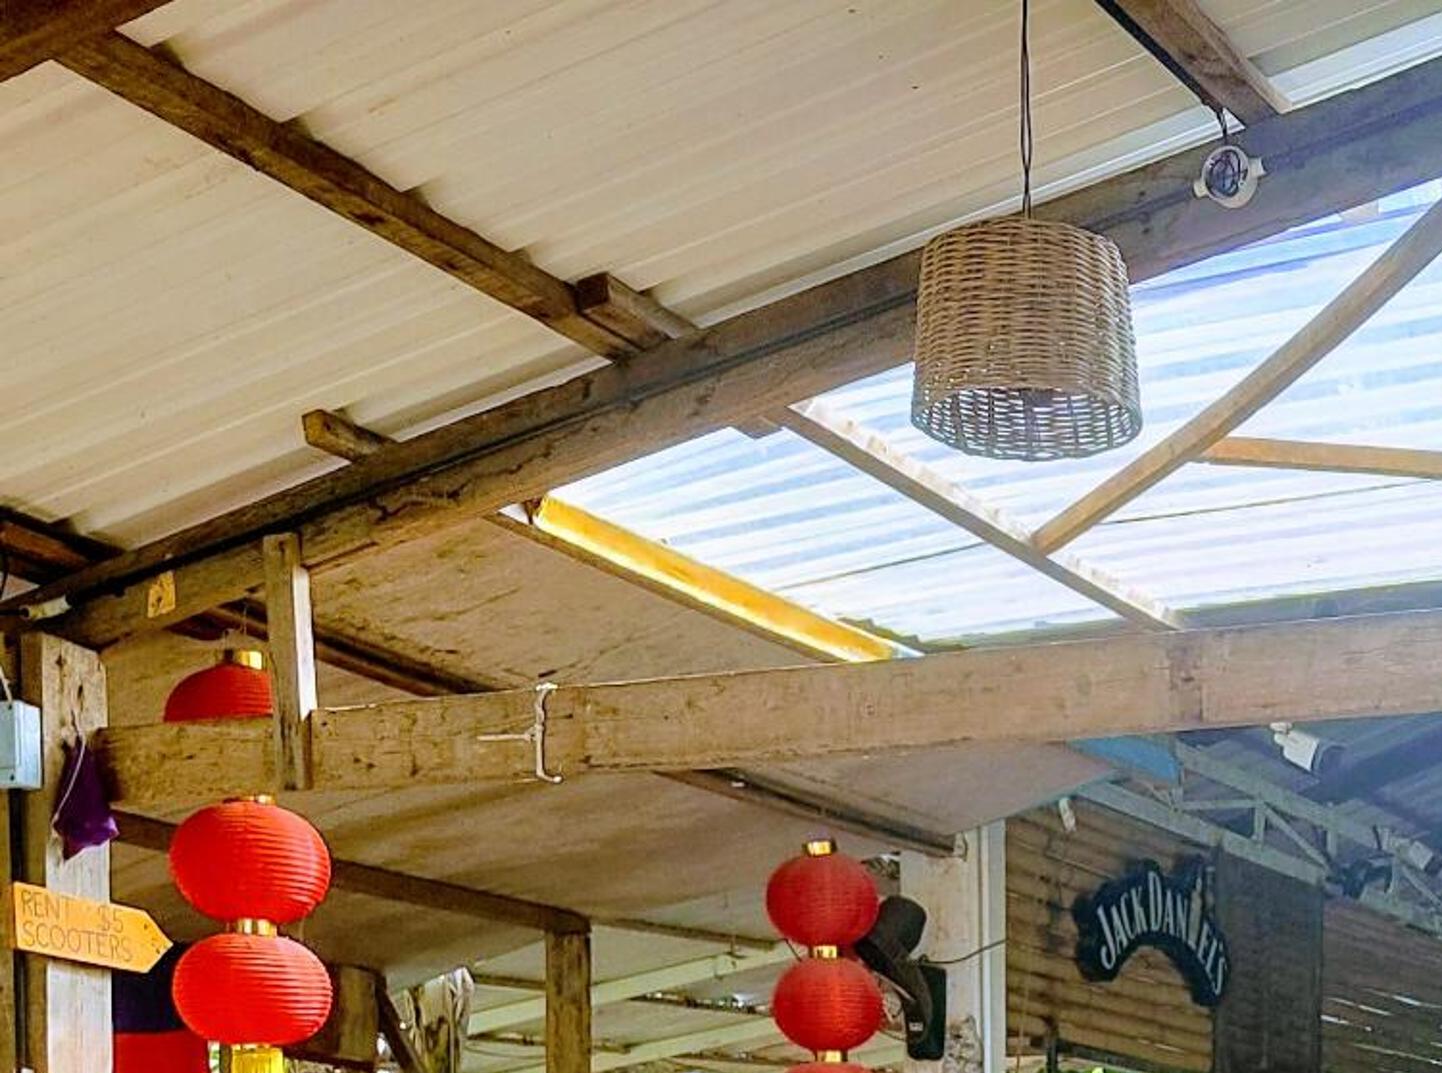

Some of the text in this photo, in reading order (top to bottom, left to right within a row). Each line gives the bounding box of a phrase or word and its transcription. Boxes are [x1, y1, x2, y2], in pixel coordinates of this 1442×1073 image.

[20, 889, 70, 919] RENT
[22, 920, 133, 962] SCOOTERS
[1097, 885, 1148, 970] JACK
